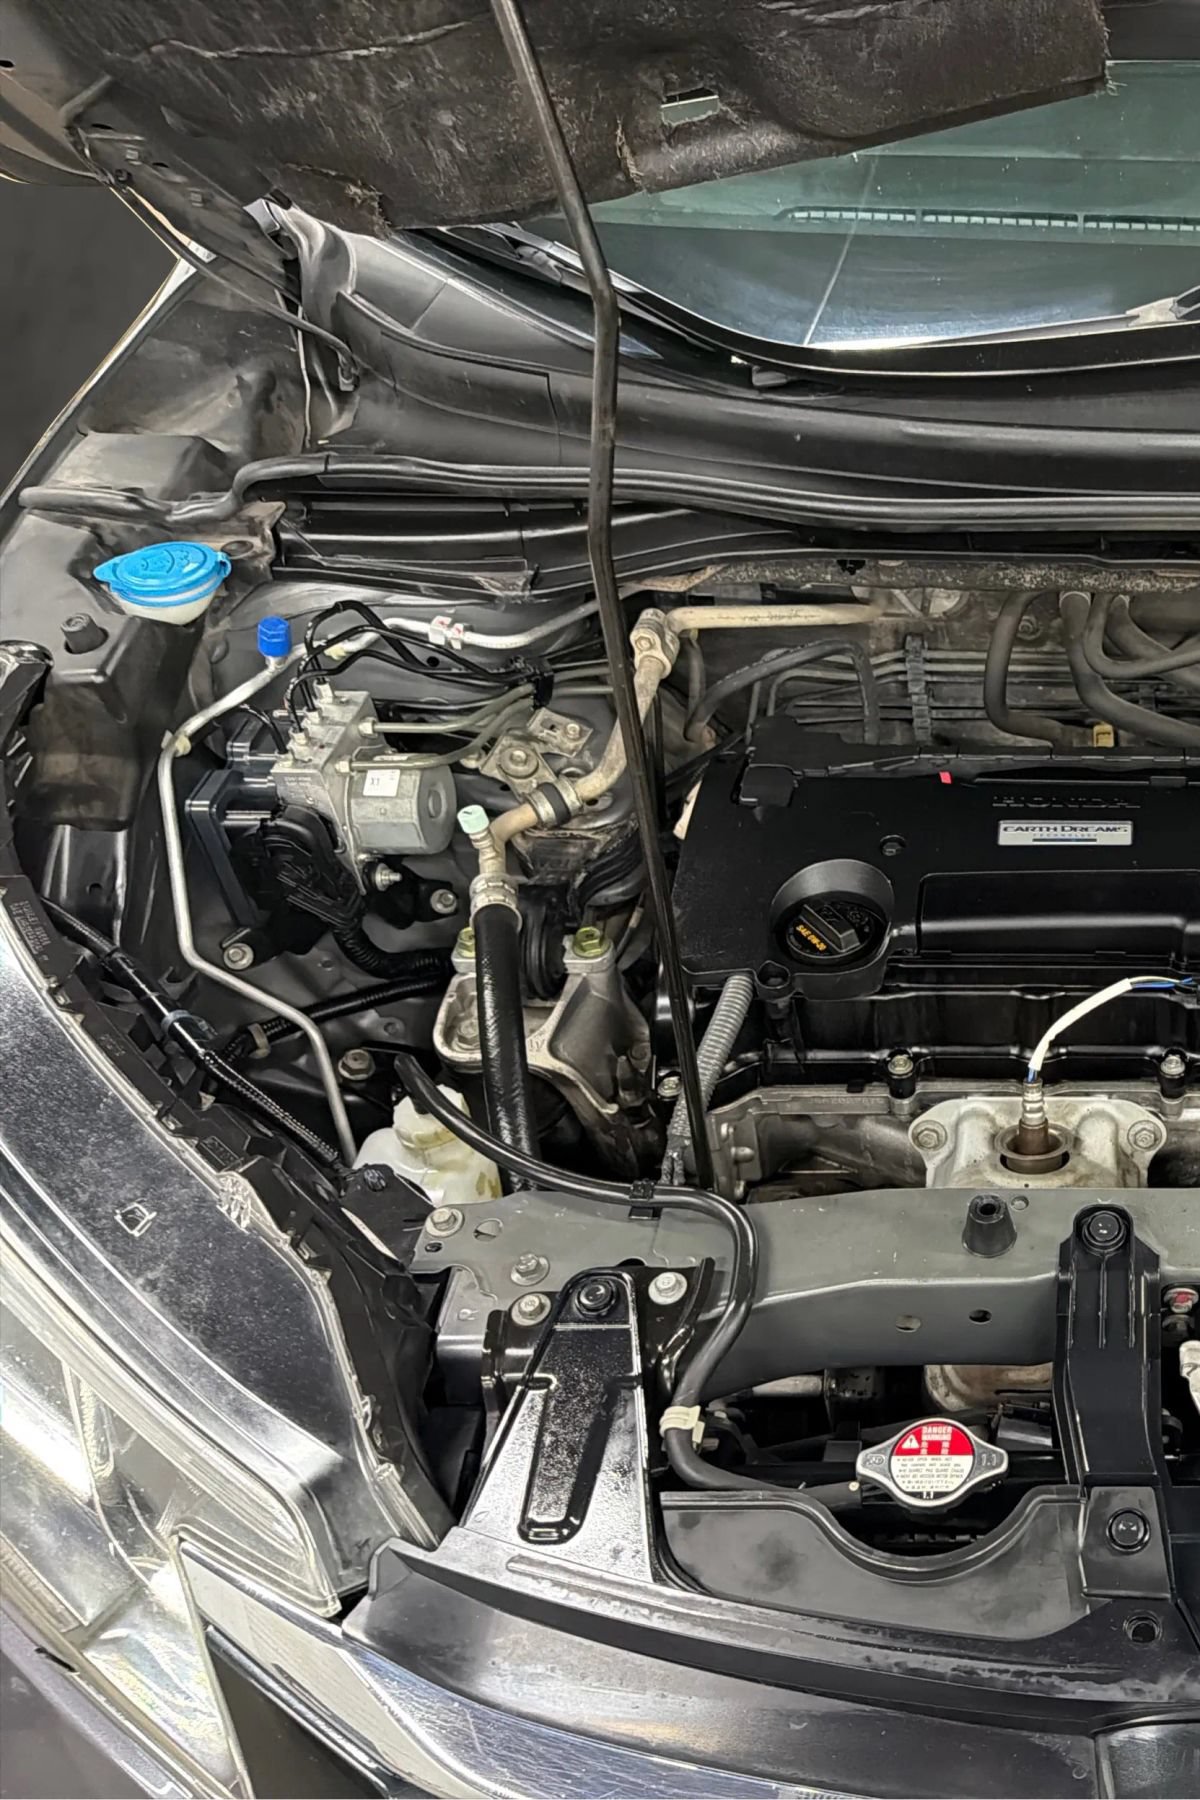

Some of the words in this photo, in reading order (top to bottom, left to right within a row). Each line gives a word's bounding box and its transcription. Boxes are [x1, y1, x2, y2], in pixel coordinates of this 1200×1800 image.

[1002, 825, 1058, 833] EARTH
[795, 924, 812, 937] SAE
[921, 1425, 953, 1434] DANGER
